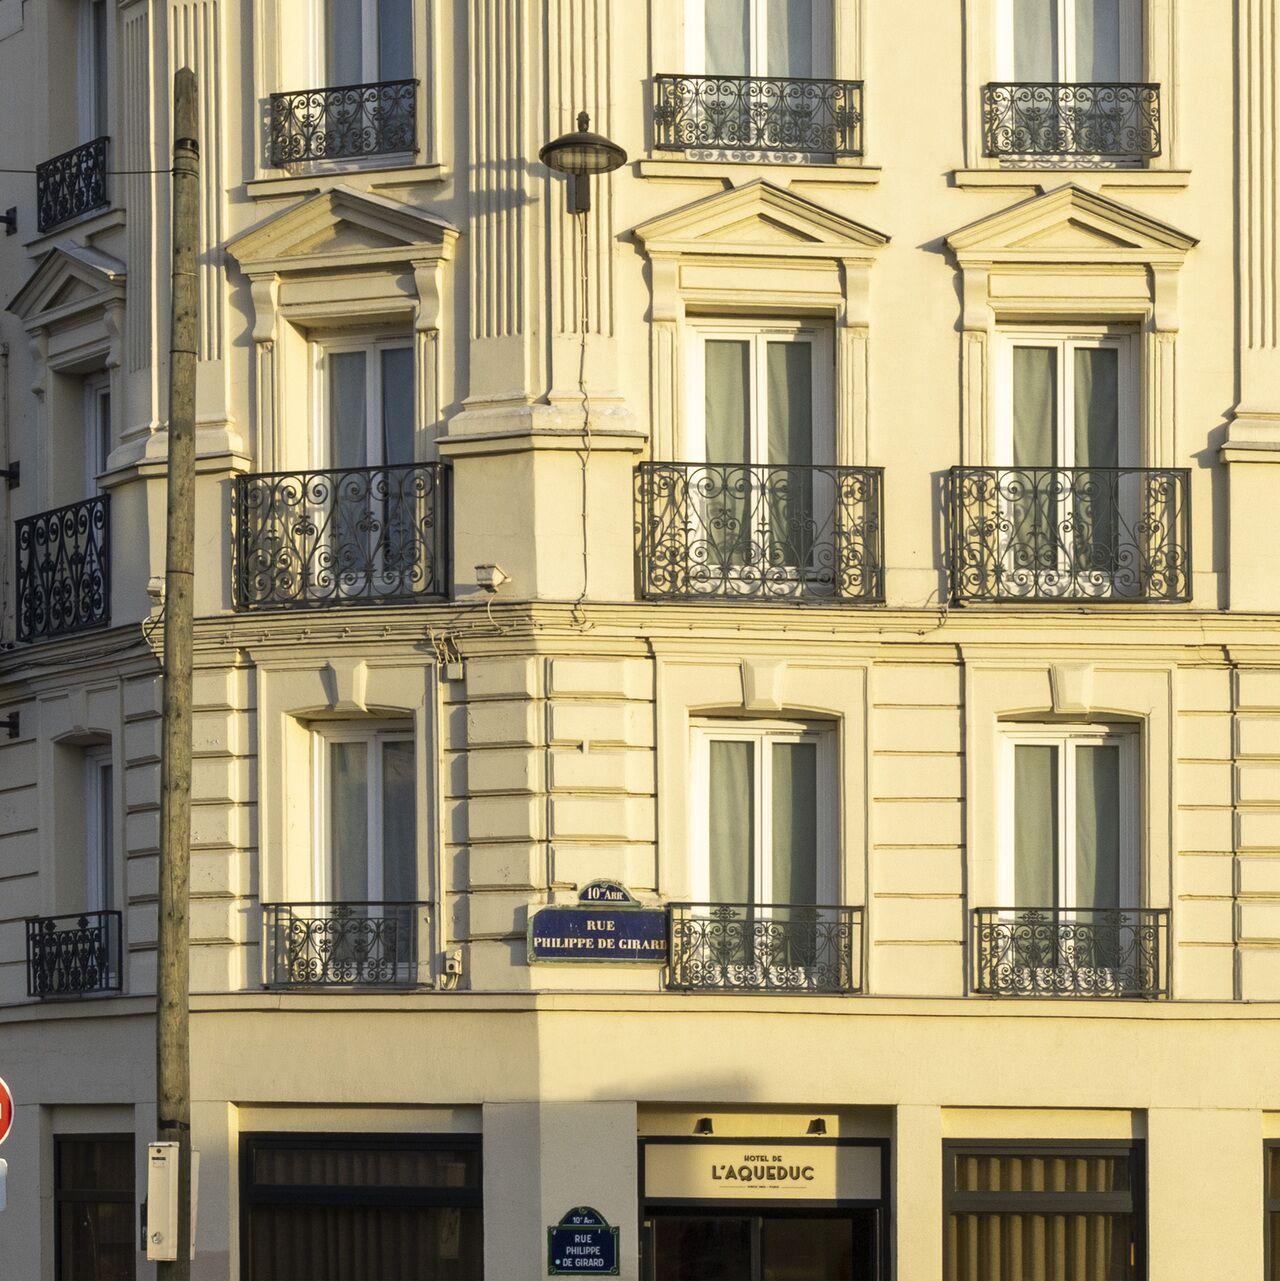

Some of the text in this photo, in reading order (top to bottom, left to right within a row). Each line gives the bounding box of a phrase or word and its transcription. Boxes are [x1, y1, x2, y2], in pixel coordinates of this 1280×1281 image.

[586, 920, 615, 931] RUE
[533, 937, 594, 948] PHILIPPE
[597, 938, 616, 949] DE
[711, 1165, 814, 1182] L'AQUEDUC
[574, 1234, 592, 1243] RUE
[566, 1246, 601, 1255] PHILIPPE
[562, 1258, 604, 1267] DE GIRARD
